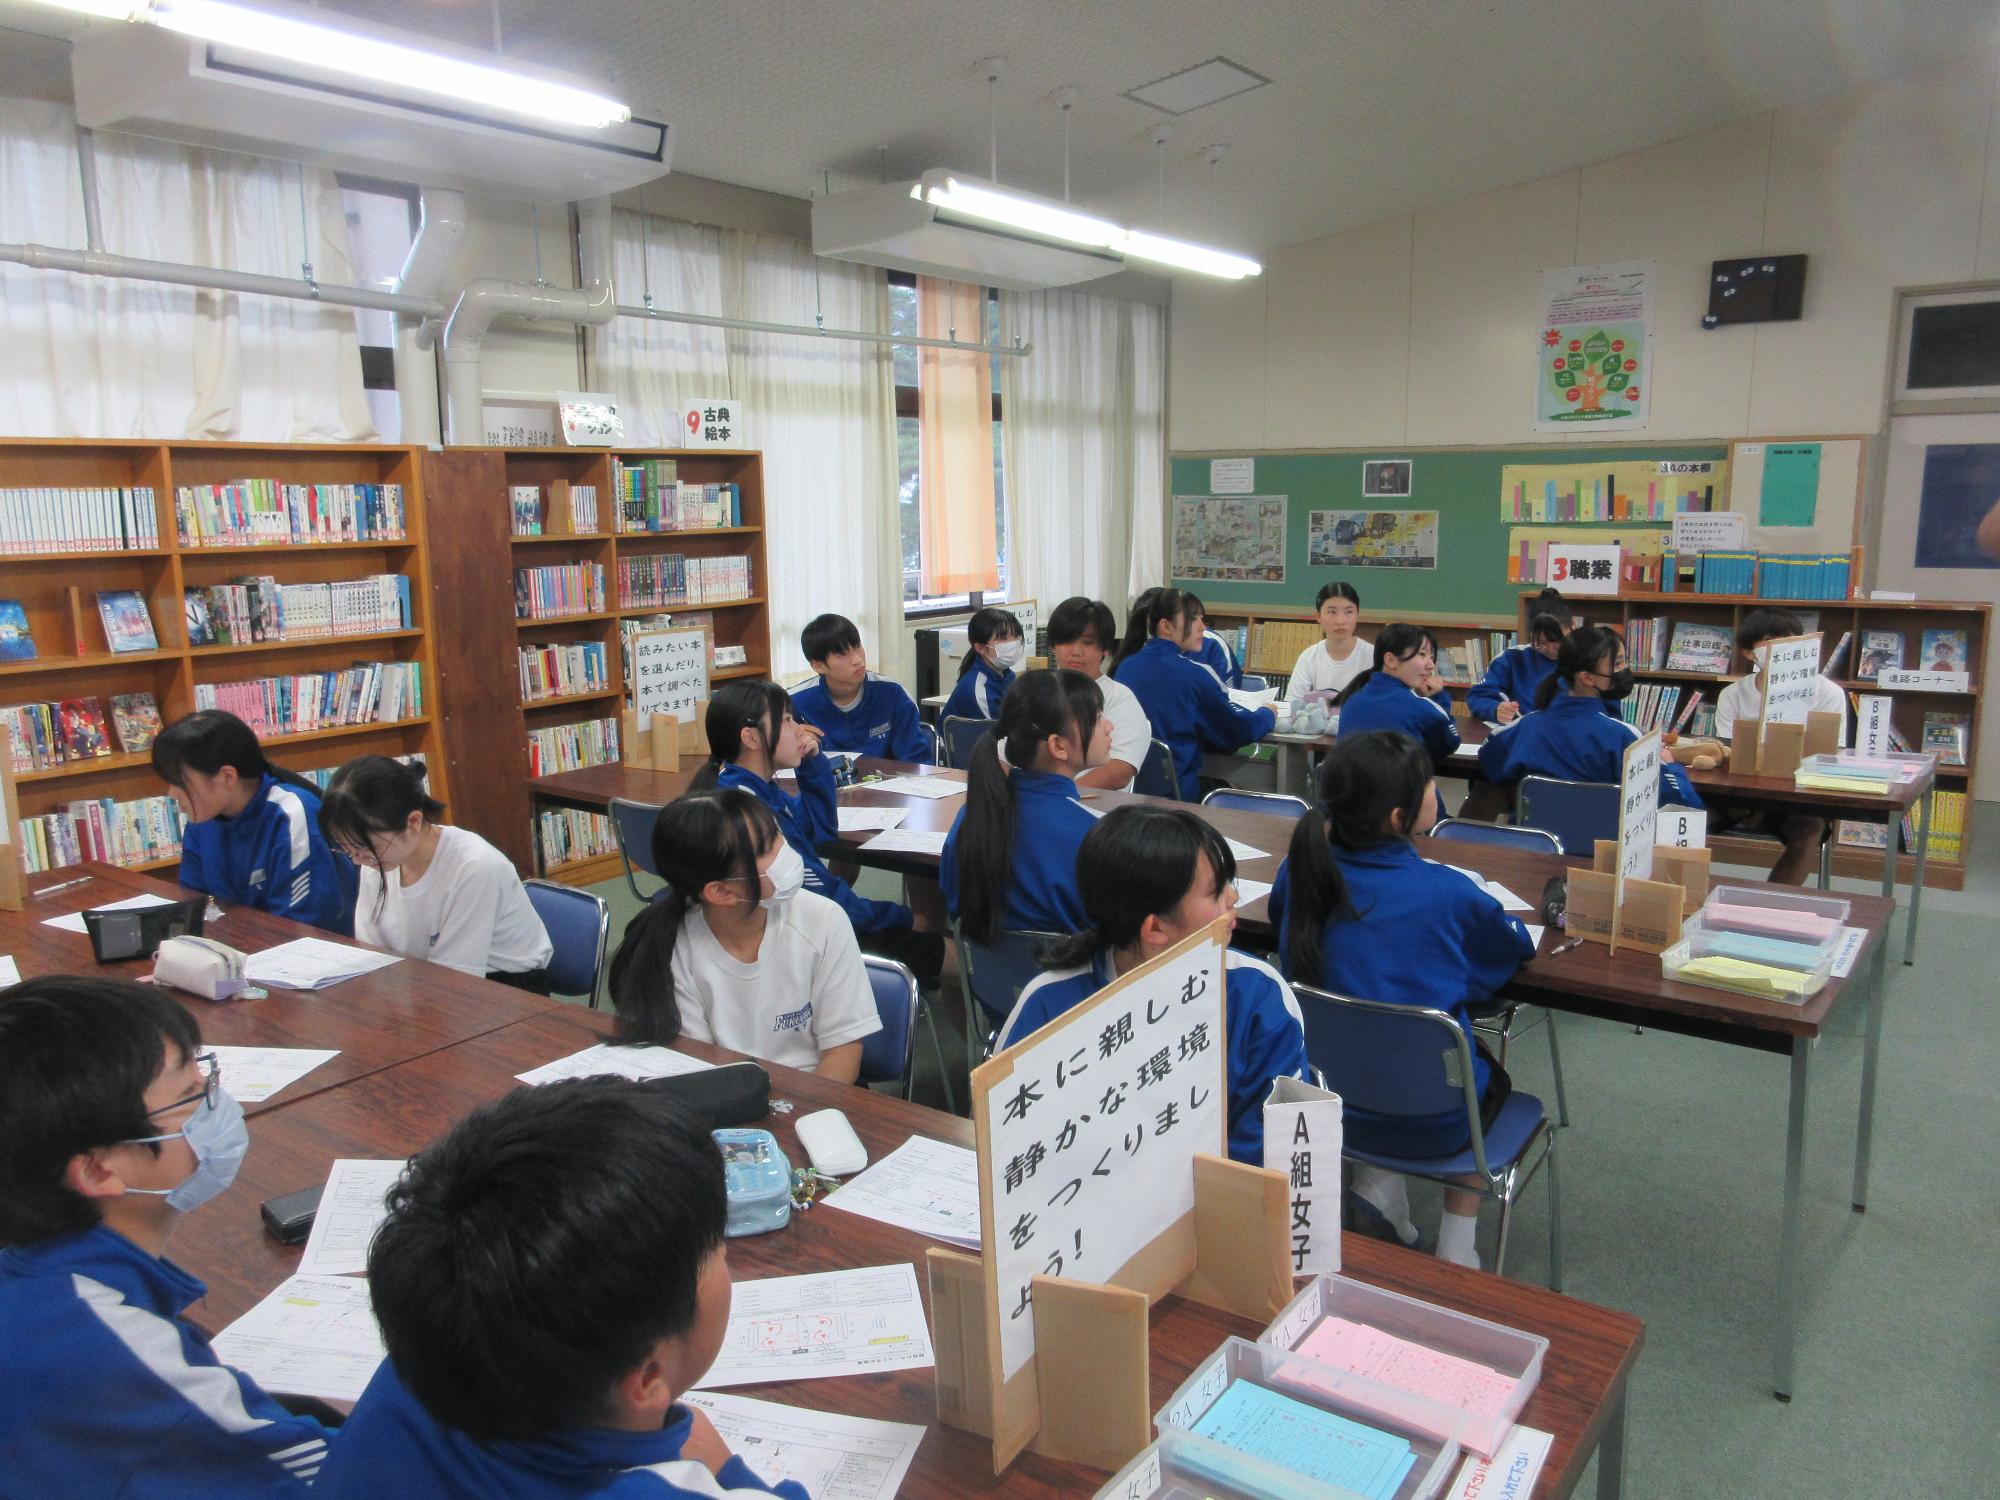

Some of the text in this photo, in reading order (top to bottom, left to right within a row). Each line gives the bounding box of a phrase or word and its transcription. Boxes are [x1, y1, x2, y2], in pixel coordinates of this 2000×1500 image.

[687, 410, 700, 435] 9
[704, 407, 730, 422] 古典
[705, 426, 731, 441] 絵本
[639, 640, 702, 656] 読みたい本
[1682, 639, 1722, 650] 仕事図鑑
[1773, 648, 1818, 663] 本に親しむ
[641, 678, 702, 695] 本で調べた
[1889, 674, 1955, 684] 進路コーナー
[1002, 970, 1209, 1125] 本に親しむ
[1004, 1022, 1211, 1194] 静かな環境
[1009, 1087, 1210, 1250] をつくりまし
[1290, 1112, 1312, 1271] A組女子
